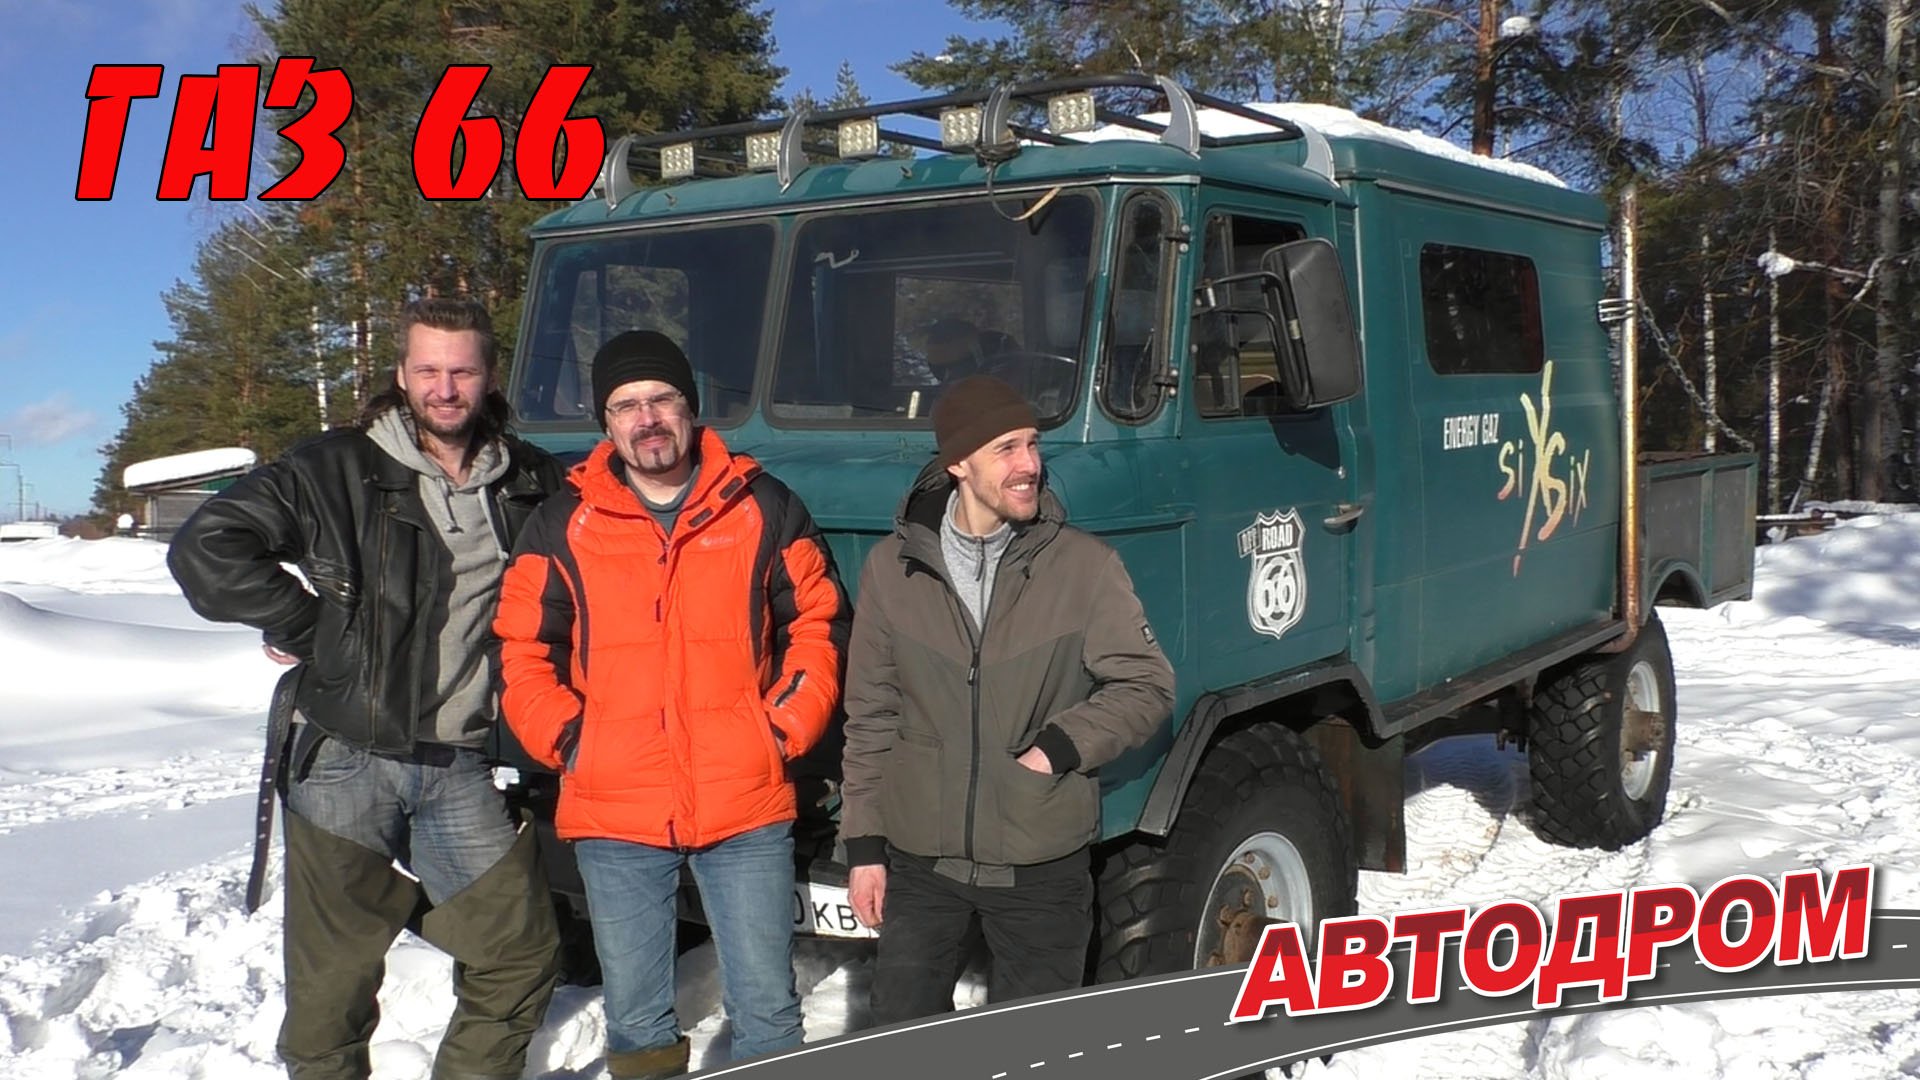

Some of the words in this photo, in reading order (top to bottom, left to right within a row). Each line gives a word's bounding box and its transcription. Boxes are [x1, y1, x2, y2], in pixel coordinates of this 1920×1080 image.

[1443, 415, 1480, 450] ENERGY
[1482, 413, 1500, 444] GAZ
[1262, 524, 1294, 551] ROAD
